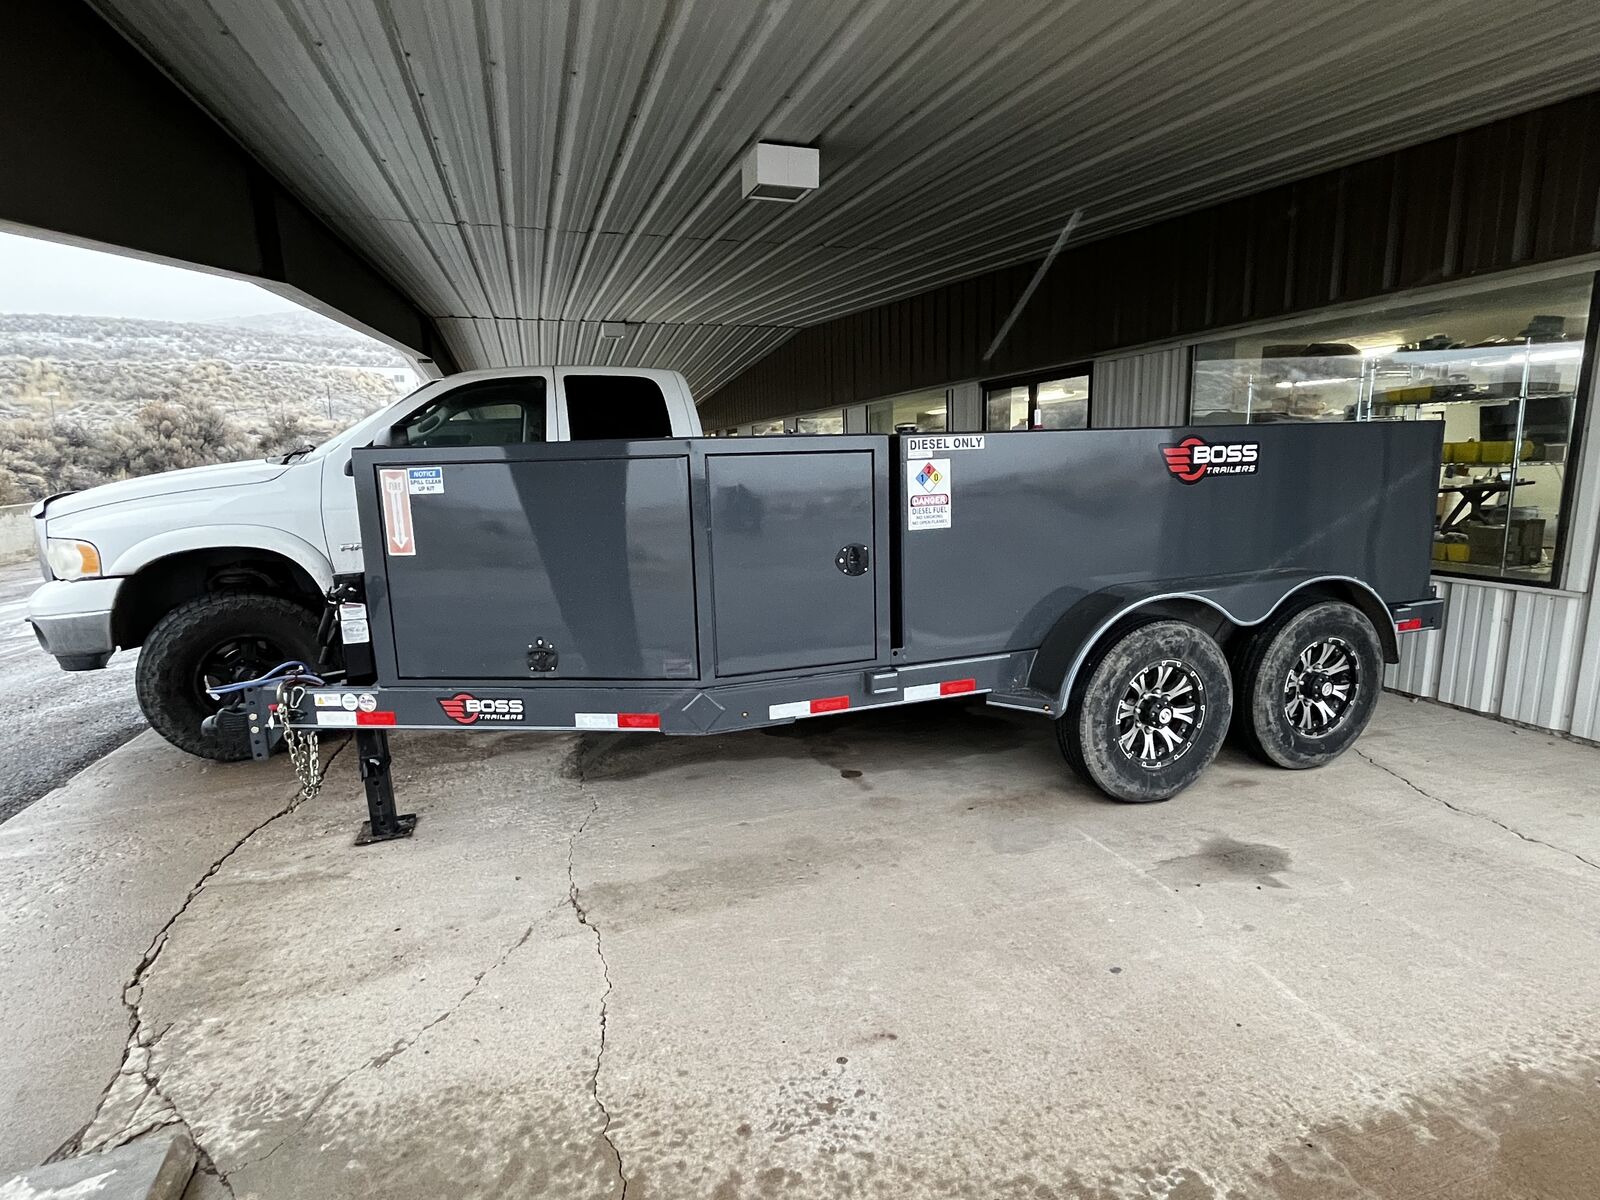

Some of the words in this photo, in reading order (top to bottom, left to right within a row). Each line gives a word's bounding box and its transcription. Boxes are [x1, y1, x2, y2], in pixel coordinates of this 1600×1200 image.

[910, 439, 950, 450] DIESEL
[953, 437, 983, 448] ONLY
[1193, 444, 1258, 464] BOSS
[1206, 464, 1256, 474] TRAILERS
[413, 470, 436, 478] NOTICE
[933, 473, 939, 482] 0
[912, 496, 947, 505] DANGER
[912, 507, 931, 515] DIESEL
[465, 699, 524, 713] BOSS
